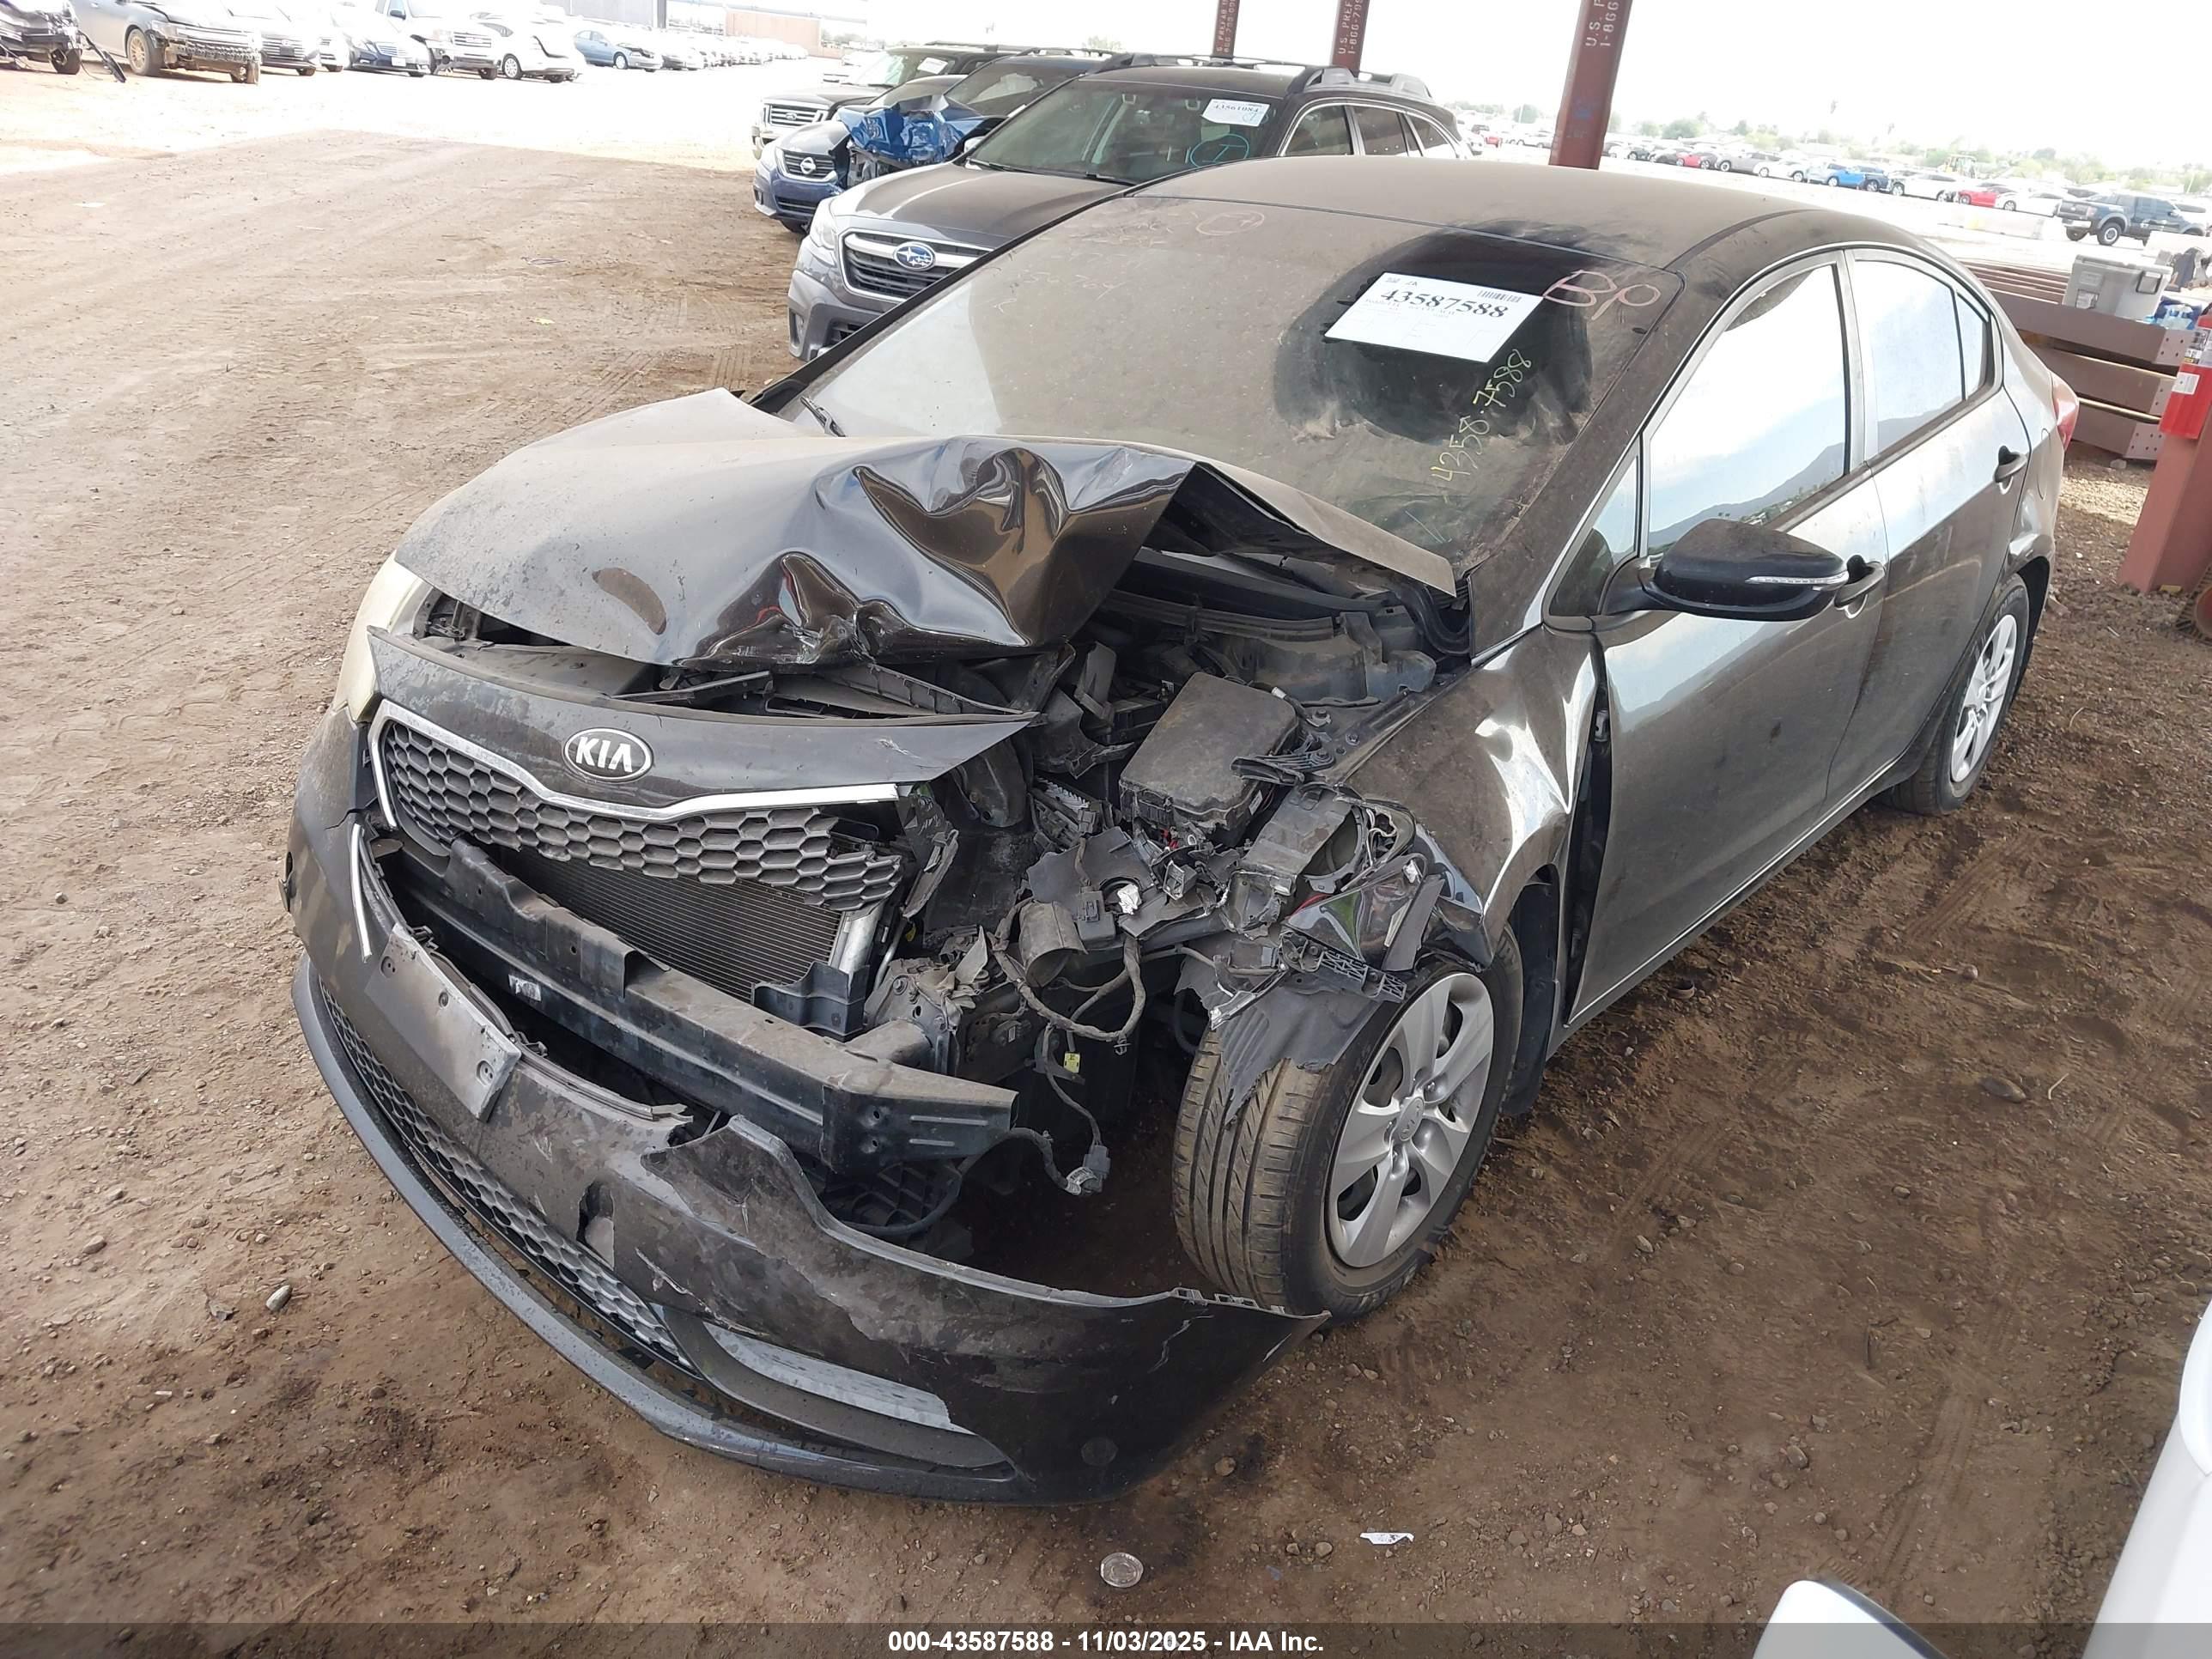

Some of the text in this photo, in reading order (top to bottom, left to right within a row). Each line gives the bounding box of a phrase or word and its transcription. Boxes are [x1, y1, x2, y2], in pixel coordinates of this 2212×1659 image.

[1585, 17, 1602, 46] U.S.
[1381, 289, 1509, 318] 43587588
[575, 737, 633, 773] KIA
